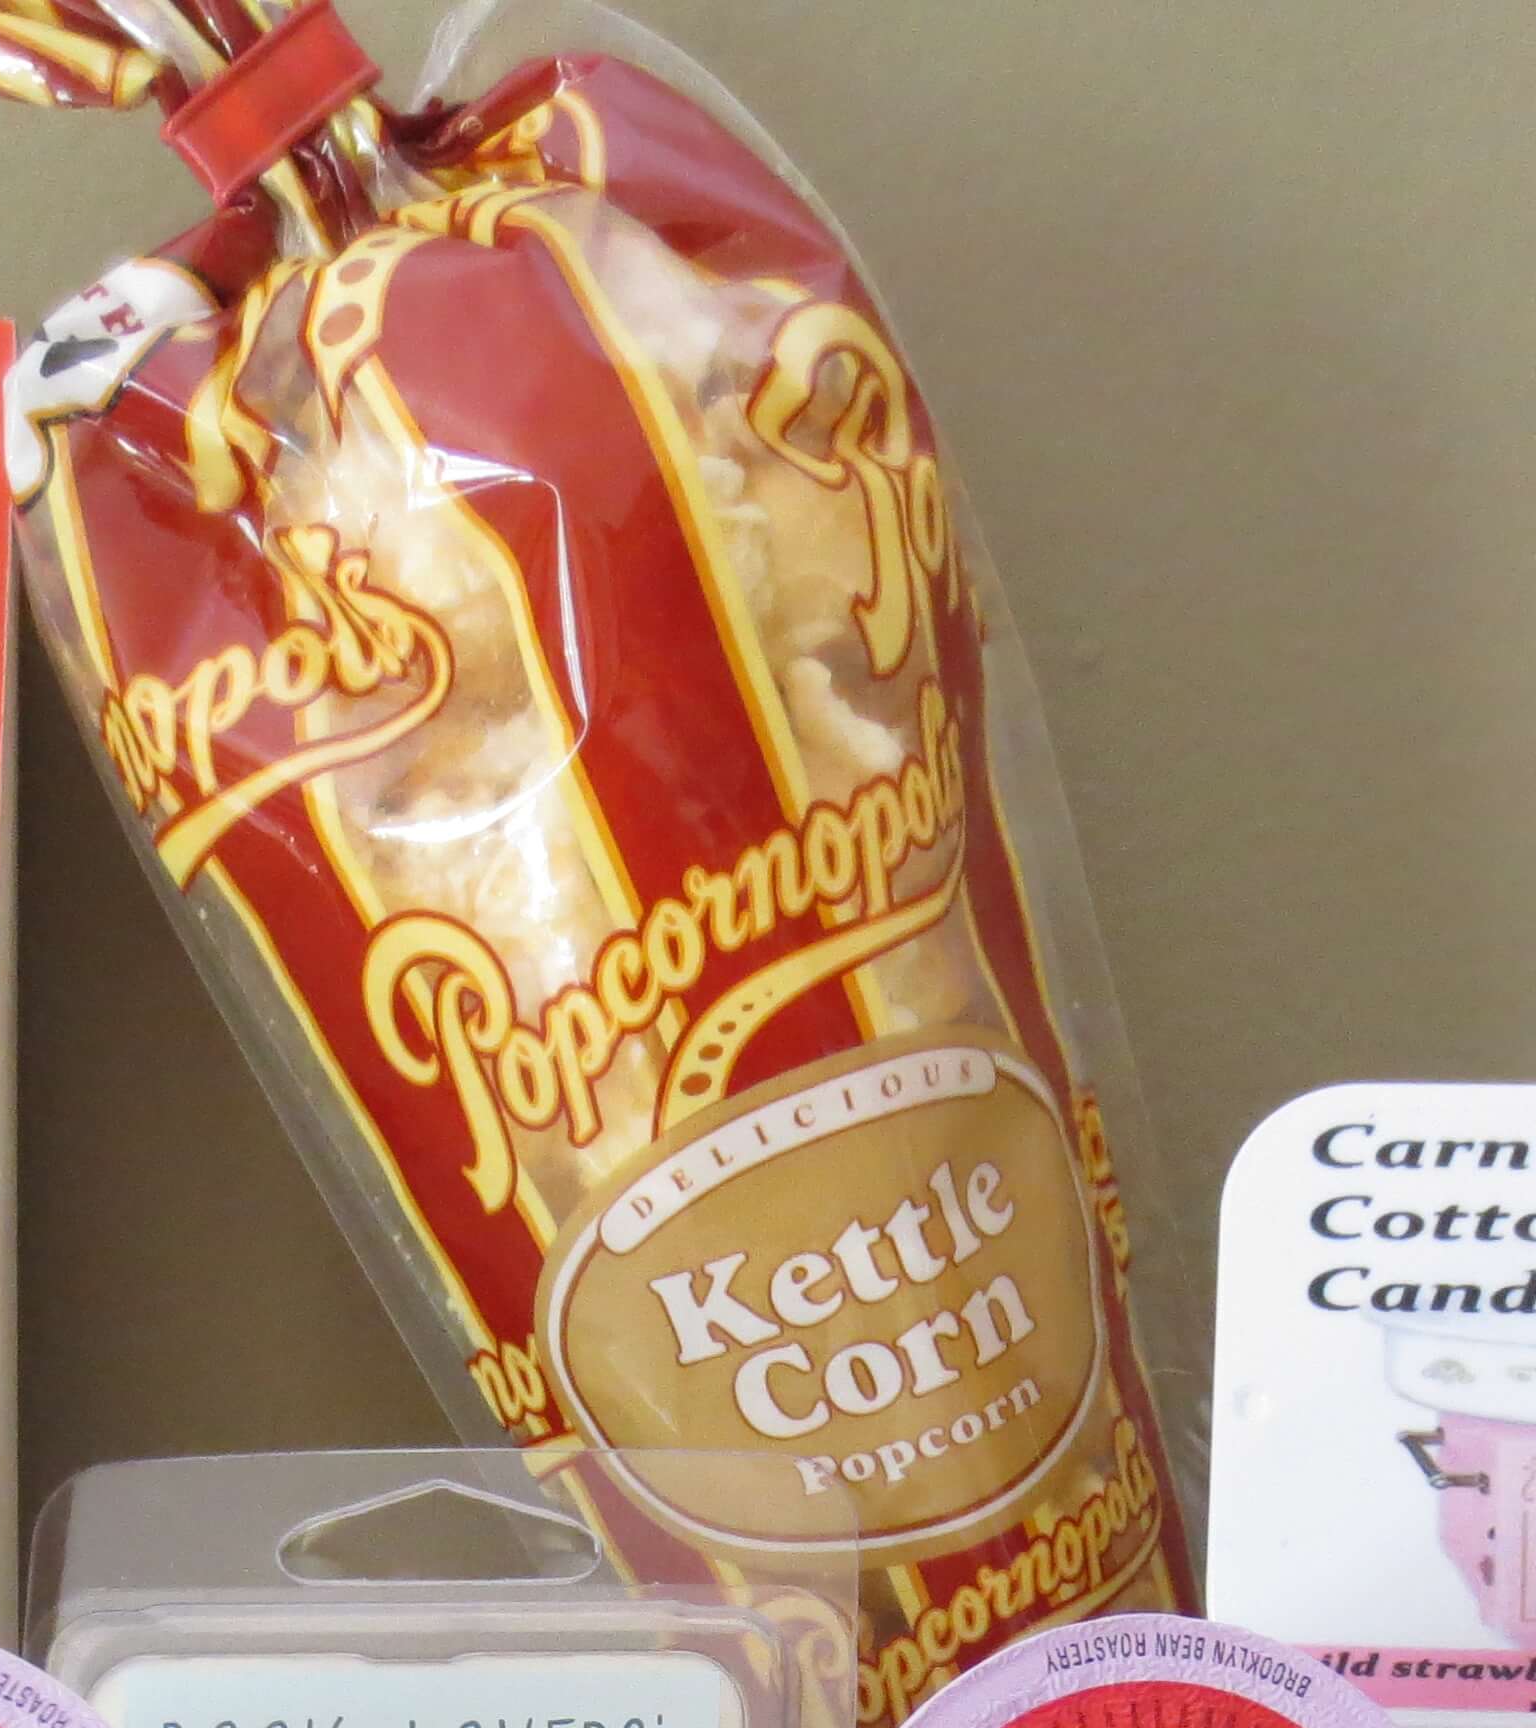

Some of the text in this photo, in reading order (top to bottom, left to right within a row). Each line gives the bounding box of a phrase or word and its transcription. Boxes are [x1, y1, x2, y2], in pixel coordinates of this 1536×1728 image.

[628, 1059, 973, 1221] DELICIOUS
[648, 1160, 1015, 1367] Kettle
[732, 1273, 1036, 1440] Corn
[794, 1377, 1043, 1496] Popcorn
[1045, 1631, 1313, 1699] BROOKLYN BEAN ROASTERY
